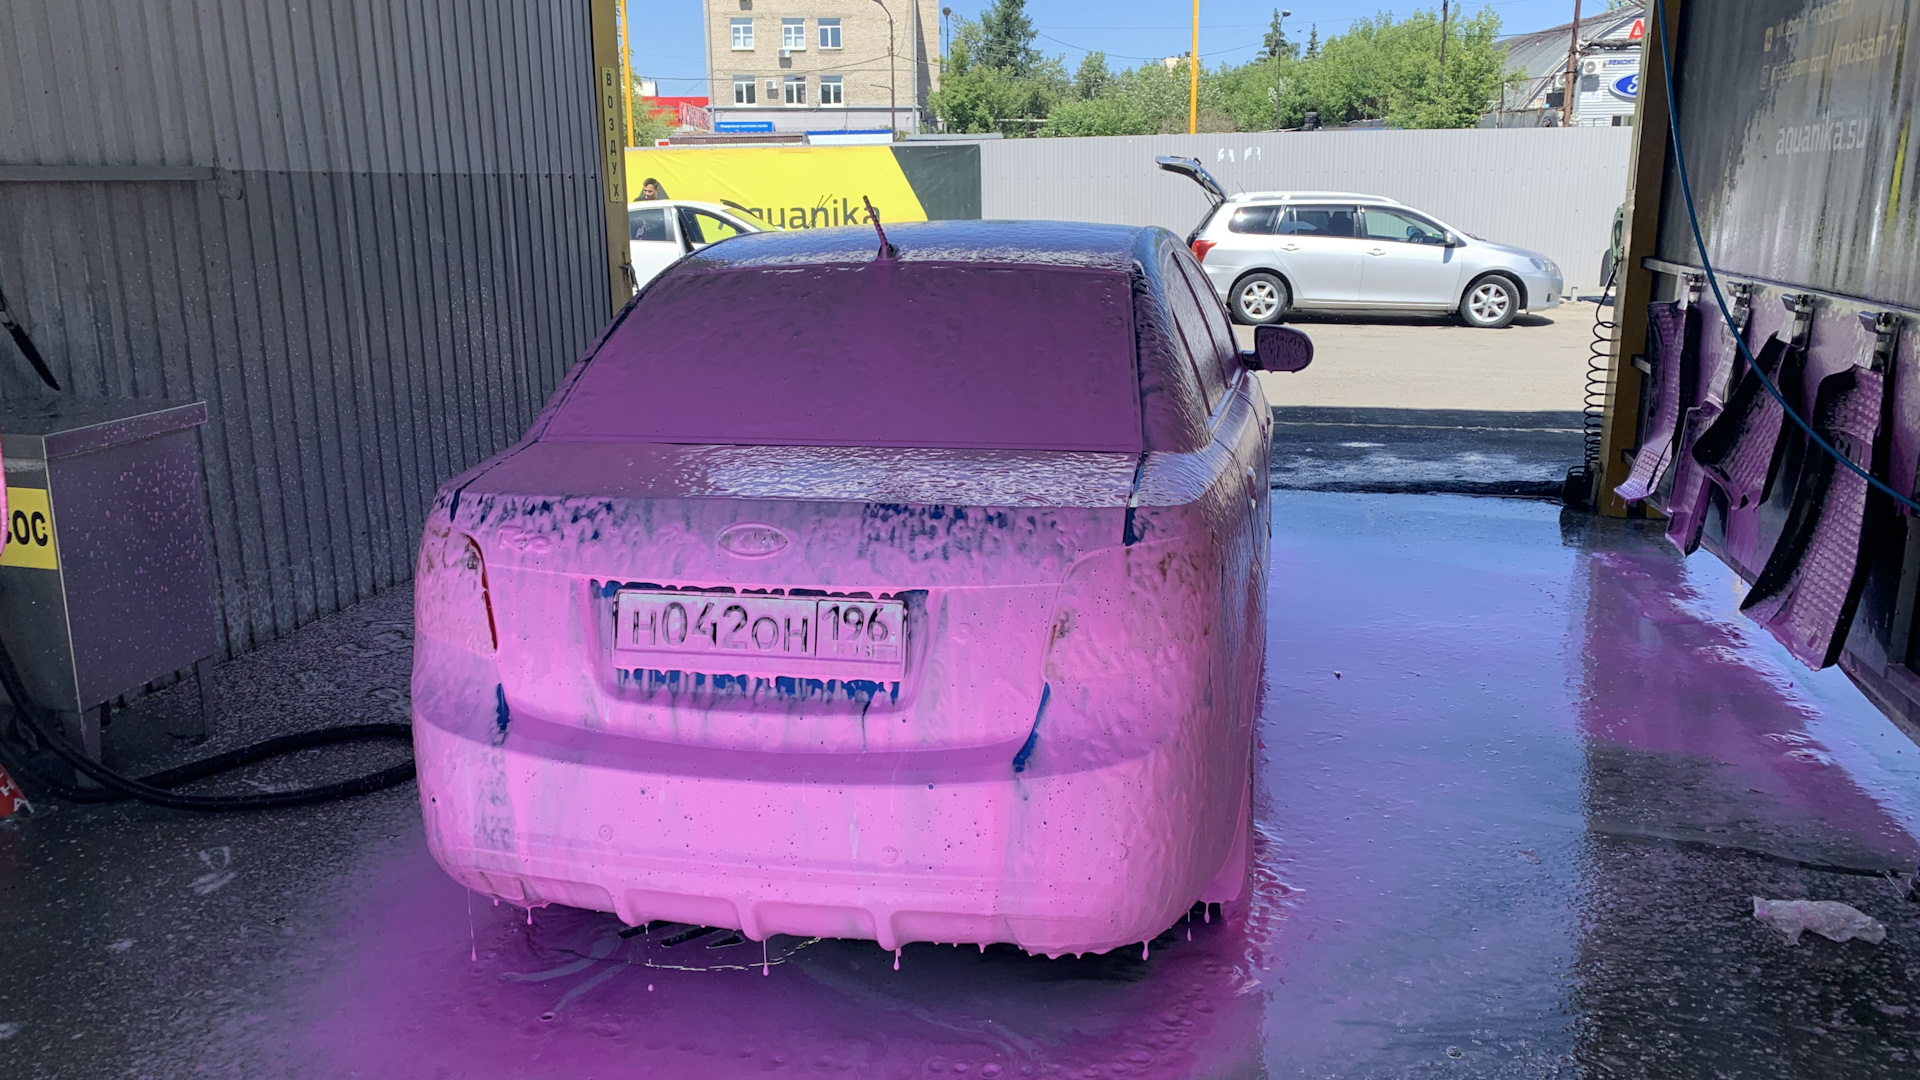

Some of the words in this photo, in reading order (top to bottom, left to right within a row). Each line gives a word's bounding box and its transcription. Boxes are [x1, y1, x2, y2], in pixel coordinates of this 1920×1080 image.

[606, 73, 619, 197] ВОЗДУХ
[1776, 110, 1868, 162] aquanika.su
[6, 509, 48, 547] ОС
[821, 604, 889, 641] 196
